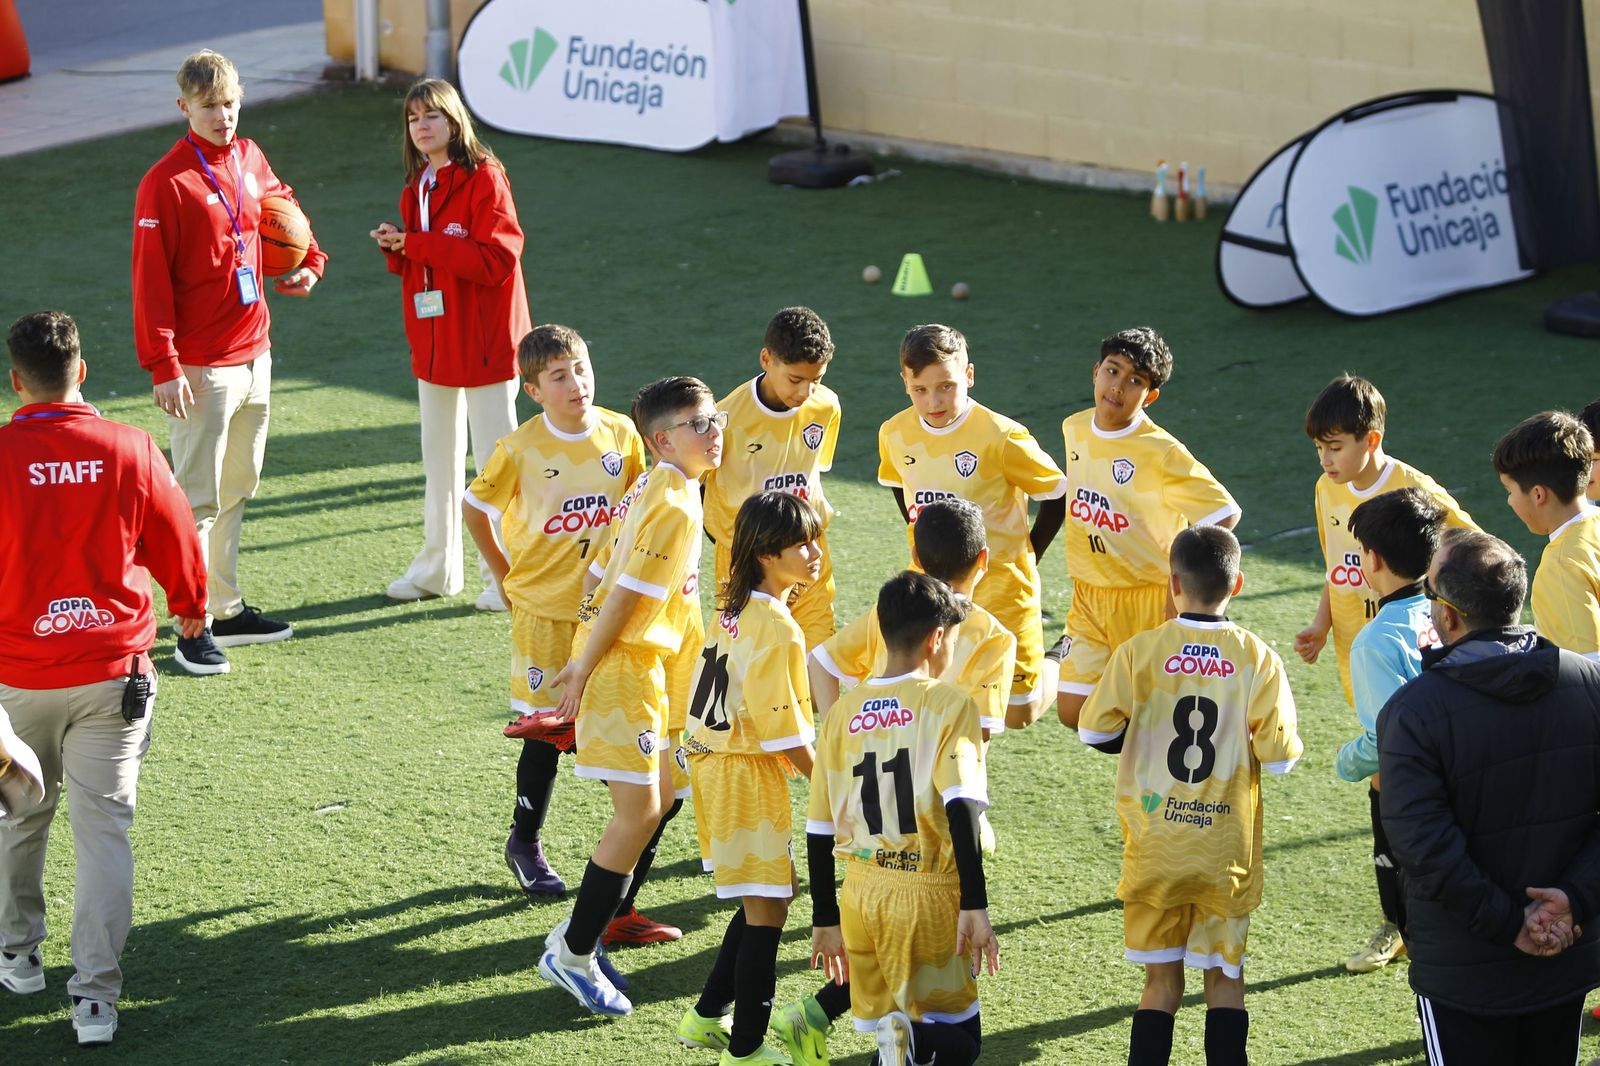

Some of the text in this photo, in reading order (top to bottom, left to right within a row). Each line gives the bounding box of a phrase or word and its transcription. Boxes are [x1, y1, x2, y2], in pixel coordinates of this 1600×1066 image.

[566, 35, 707, 79] Fundación
[563, 69, 664, 115] Unicaja
[1385, 160, 1509, 218] Fundació
[1396, 208, 1500, 257] Unicaja
[28, 460, 104, 485] STAFF
[765, 473, 808, 490] COPA
[563, 495, 608, 512] COPA
[1077, 488, 1110, 511] COPA
[1070, 499, 1130, 533] COVAP
[579, 539, 590, 559] 7
[634, 546, 668, 560] VOLVO
[1088, 533, 1106, 554] 10
[51, 599, 93, 614] COPA
[35, 609, 113, 635] COVAP
[1182, 644, 1219, 658] COPA
[1164, 655, 1235, 678] COVAP
[863, 698, 899, 712] COPA
[848, 708, 914, 734] COVAP
[1166, 695, 1219, 784] 8
[852, 747, 918, 836] 11
[1166, 796, 1231, 815] Fundación
[1164, 808, 1213, 829] Unicaja
